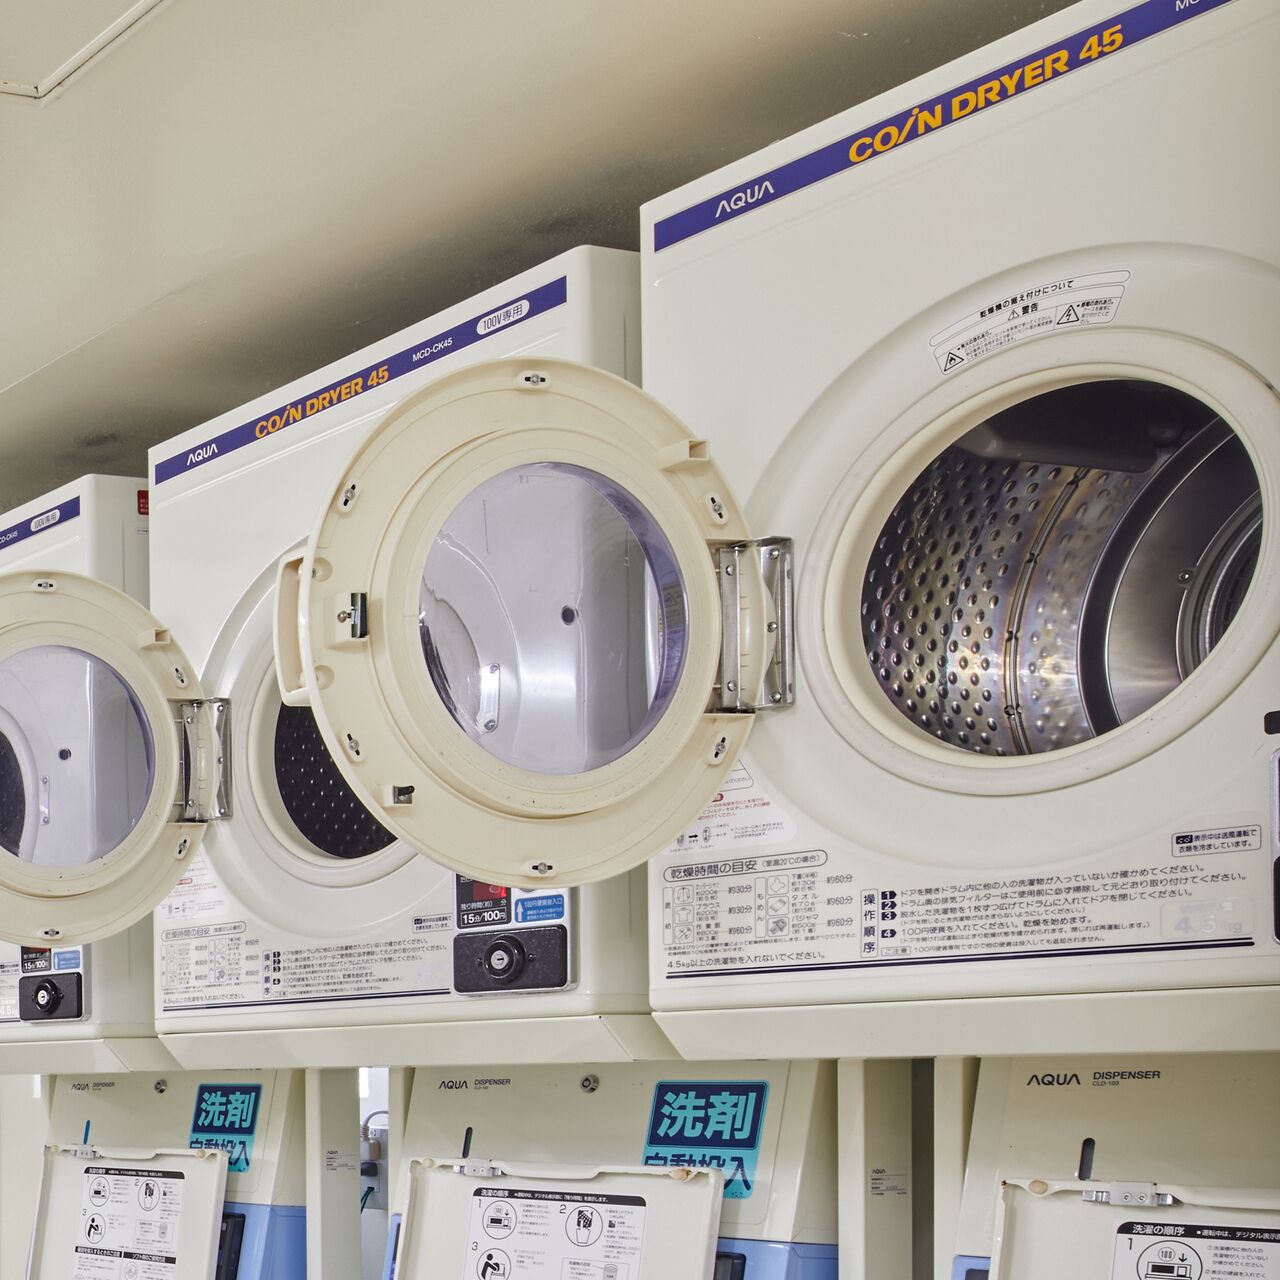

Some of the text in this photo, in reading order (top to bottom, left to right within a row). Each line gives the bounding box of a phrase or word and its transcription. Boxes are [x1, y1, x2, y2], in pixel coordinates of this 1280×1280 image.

[715, 181, 774, 217] AQUA
[951, 50, 1069, 119] DRYER
[1079, 25, 1123, 60] 45
[1022, 303, 1039, 315] 警告
[186, 444, 218, 465] AQUA
[306, 382, 364, 417] DRYER
[368, 366, 389, 387] 45
[412, 337, 453, 362] MCD-CK45
[671, 861, 757, 879] 乾燥時間の目安
[864, 894, 876, 953] 操作順序
[439, 1080, 468, 1090] AQUA
[1027, 1070, 1160, 1086] AQUA DISPENSER
[71, 1083, 89, 1091] AQUA
[197, 1092, 255, 1128] 洗剤
[657, 1091, 756, 1140] 洗剤
[560, 1204, 567, 1213] 2
[1133, 1224, 1184, 1236] 洗濯の順序
[472, 1242, 478, 1250] 3
[1128, 1238, 1132, 1250] 1
